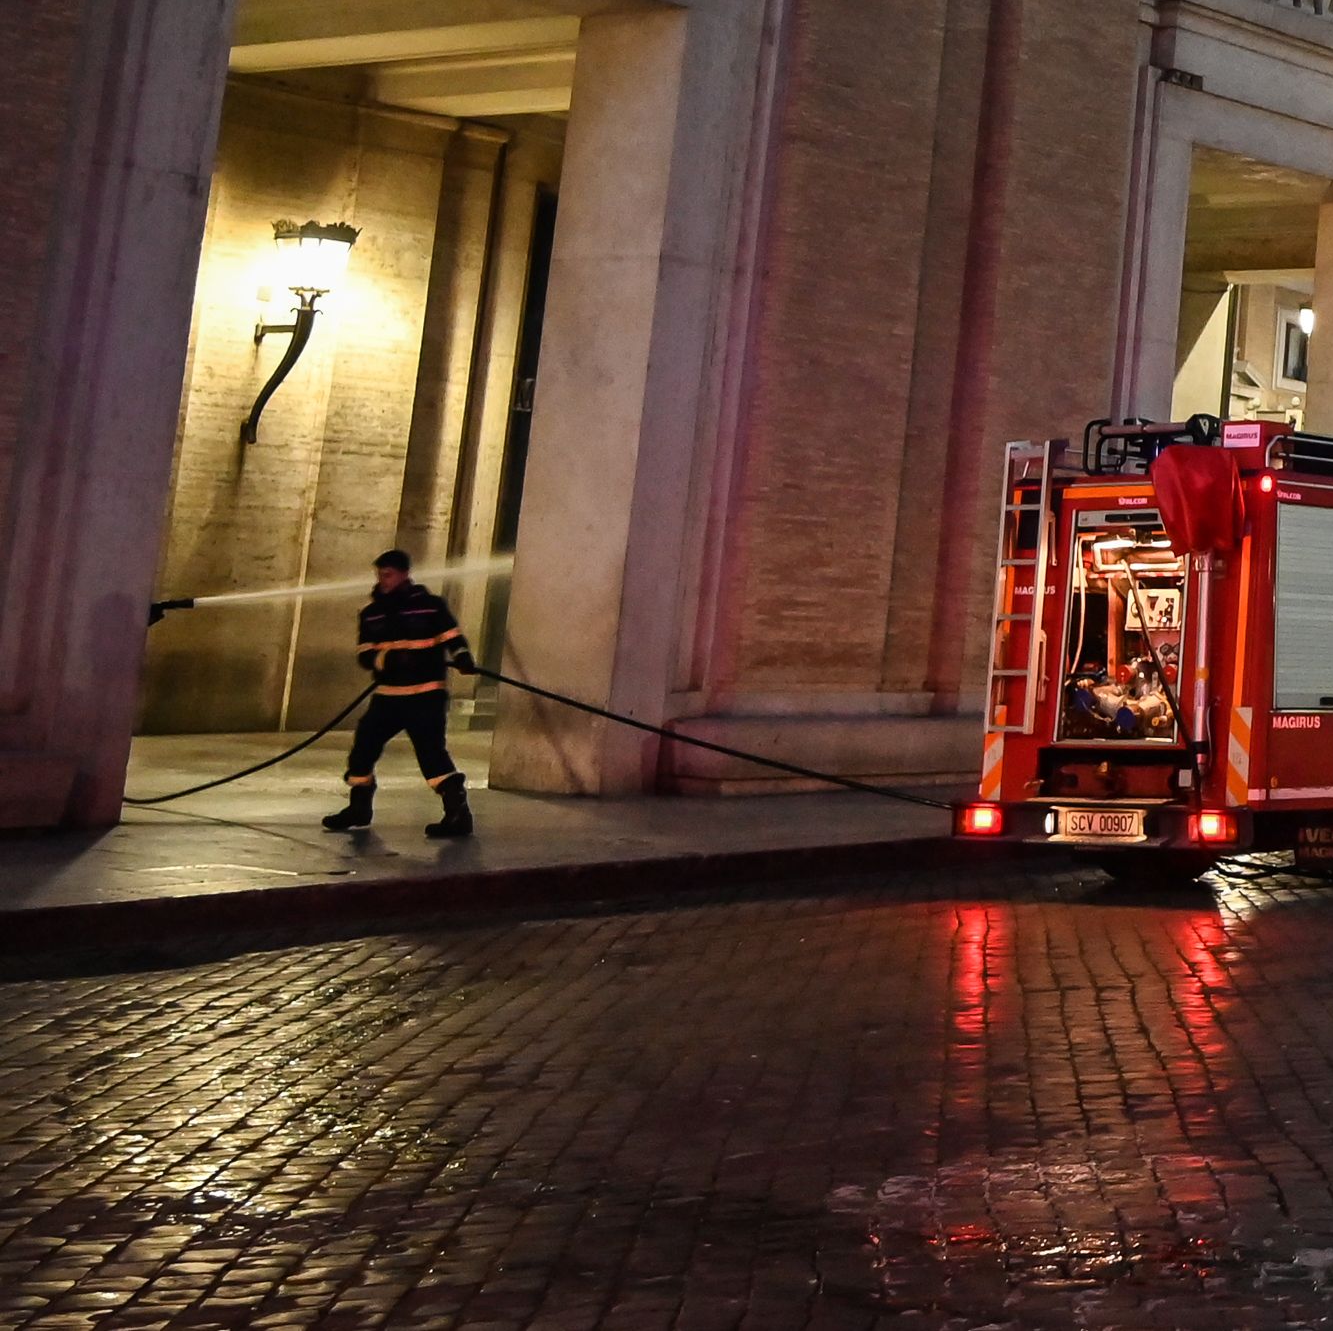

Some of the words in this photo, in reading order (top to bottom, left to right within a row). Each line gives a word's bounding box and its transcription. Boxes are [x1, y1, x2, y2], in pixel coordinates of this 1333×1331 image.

[1014, 585, 1056, 596] MAGUS
[1272, 716, 1321, 729] MAGIRUS
[1070, 815, 1094, 831] SCV
[1099, 814, 1135, 832] 00907
